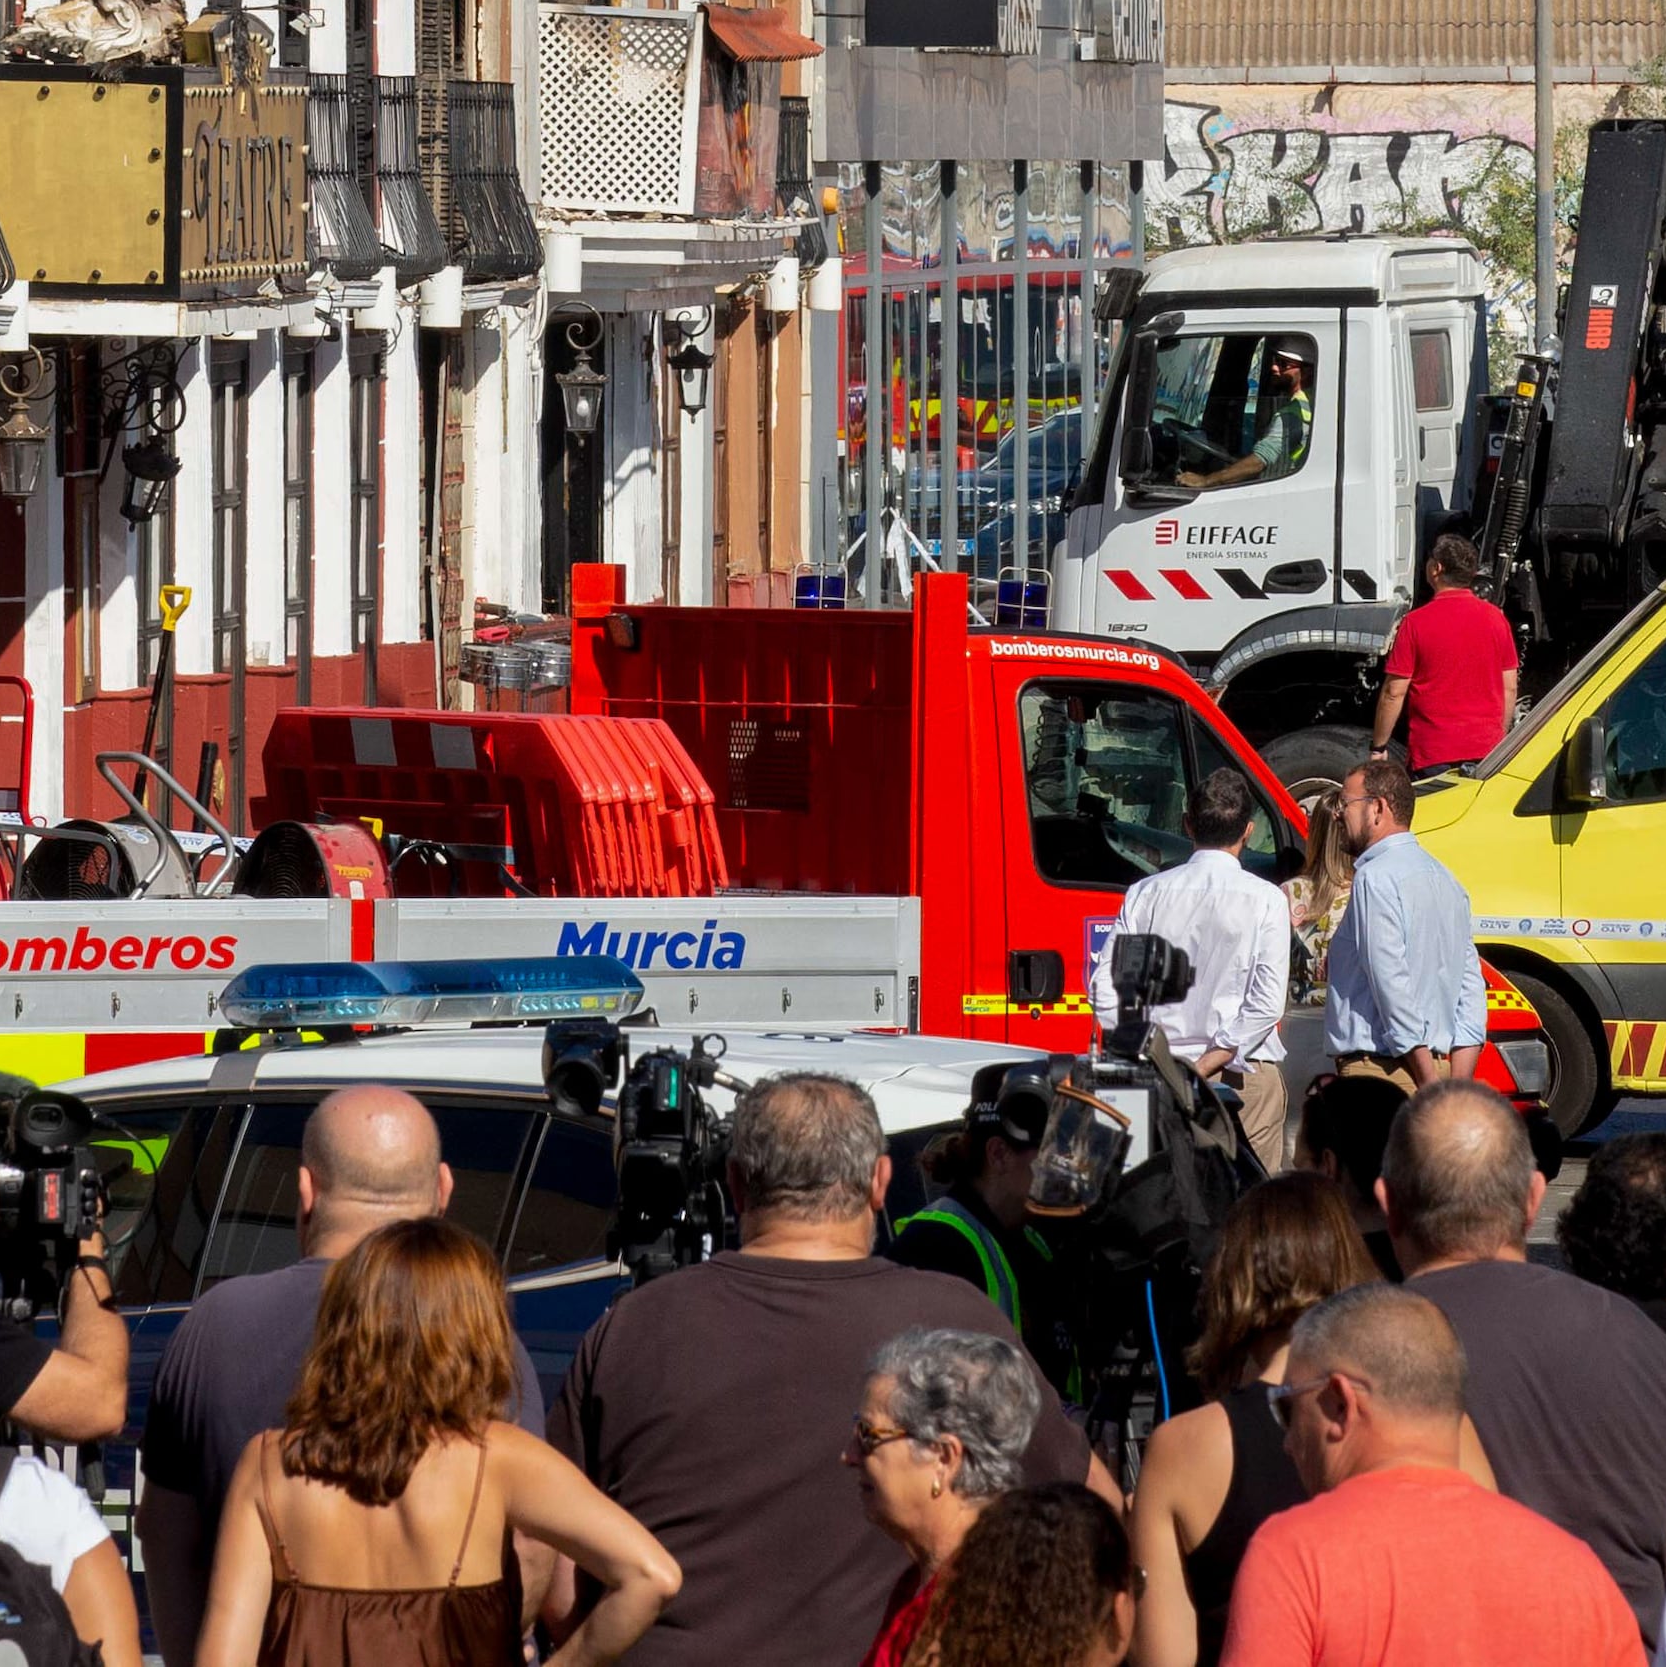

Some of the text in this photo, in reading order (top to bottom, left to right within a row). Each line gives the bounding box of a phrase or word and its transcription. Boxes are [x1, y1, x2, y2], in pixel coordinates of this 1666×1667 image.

[1586, 309, 1614, 350] HIAB
[1186, 526, 1278, 545] EIFFAGE
[1186, 550, 1268, 559] ENERGÍA SISTEMAS
[1108, 623, 1148, 632] 1830
[991, 639, 1160, 671] bomberosmurcia.org
[1601, 925, 1632, 934] ALTO
[556, 919, 746, 971] Murcia
[965, 997, 1007, 1006] Bomberos
